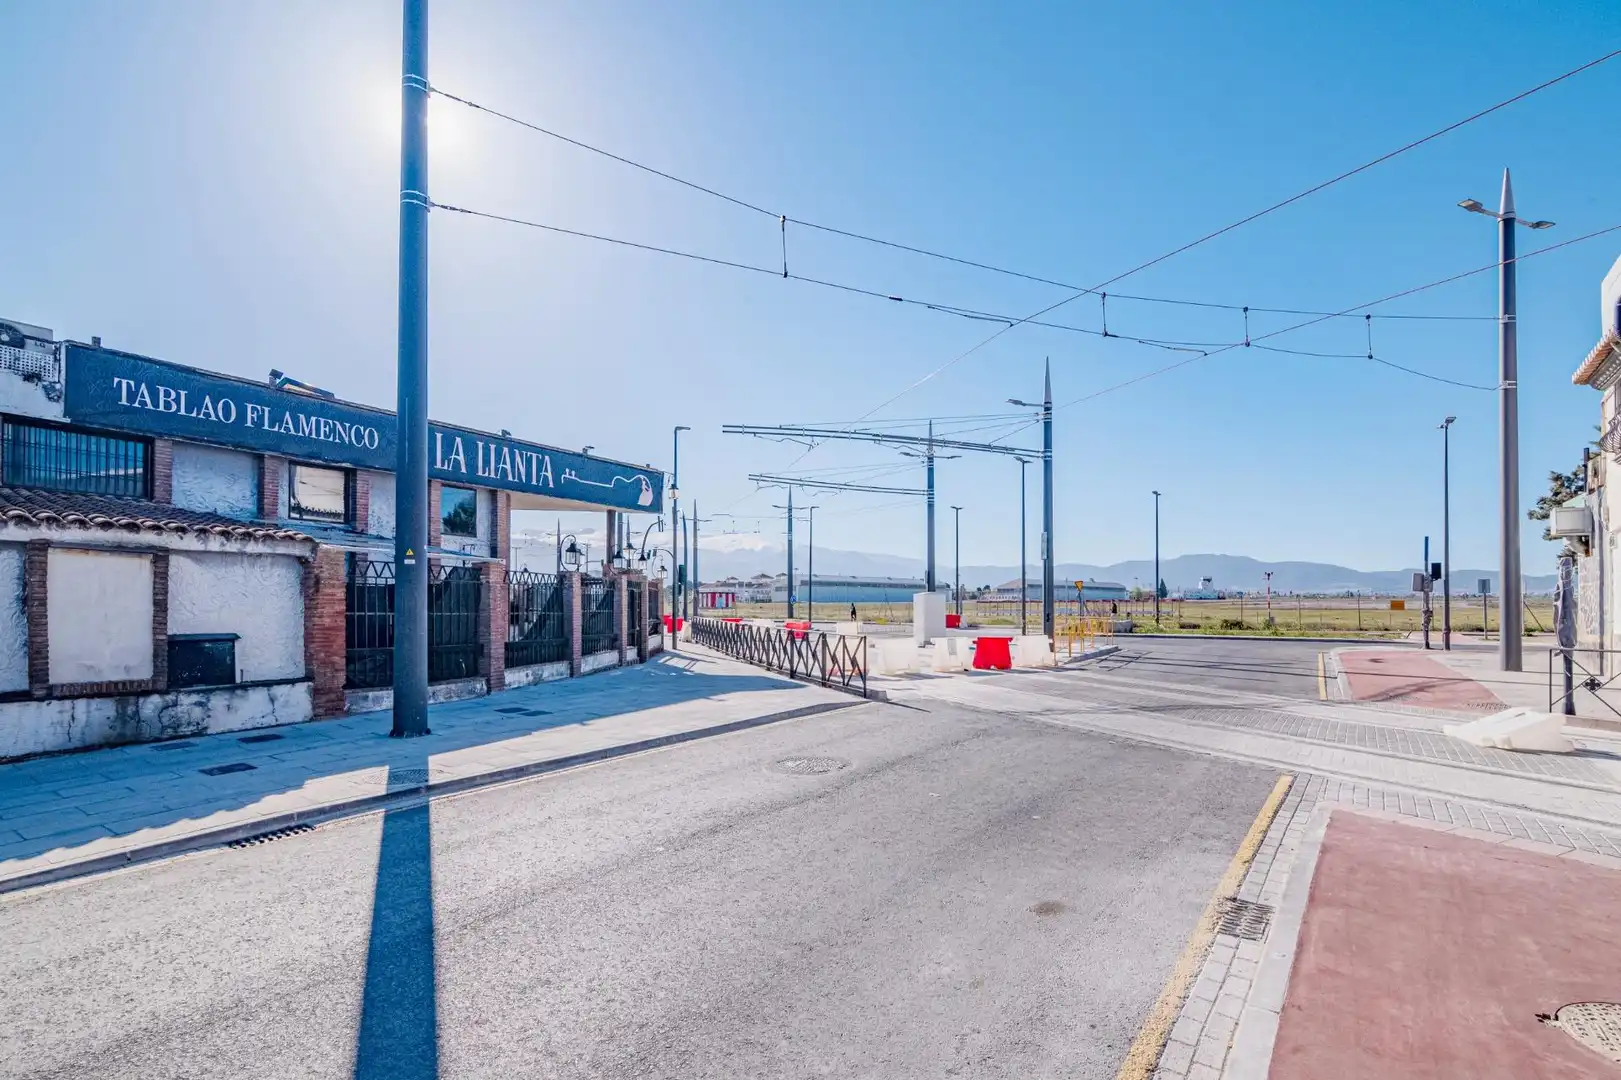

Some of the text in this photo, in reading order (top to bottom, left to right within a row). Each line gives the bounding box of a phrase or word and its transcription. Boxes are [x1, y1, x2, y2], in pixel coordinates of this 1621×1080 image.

[114, 377, 554, 488] TABLAO FLAMENCO LA LIANTA
